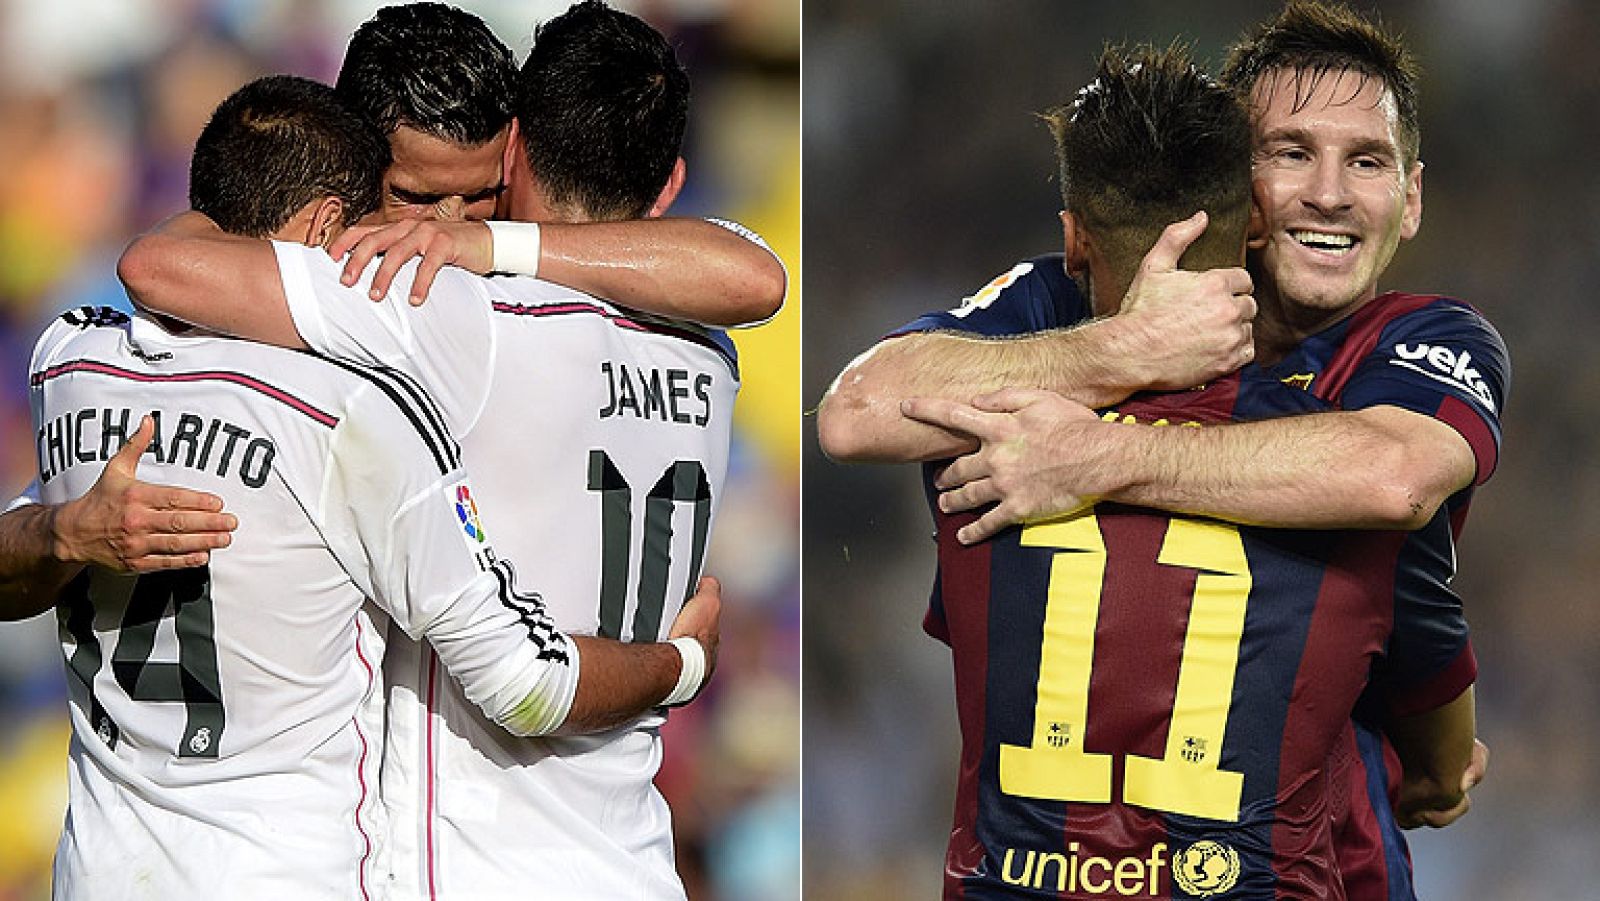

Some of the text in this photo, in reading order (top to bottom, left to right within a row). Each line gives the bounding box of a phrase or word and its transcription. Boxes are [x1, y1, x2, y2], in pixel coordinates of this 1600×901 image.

[599, 361, 713, 428] JAMES
[37, 408, 277, 489] CHICHARITO
[586, 449, 713, 643] 10
[999, 514, 1253, 823] 11
[1000, 841, 1168, 896] unicef
